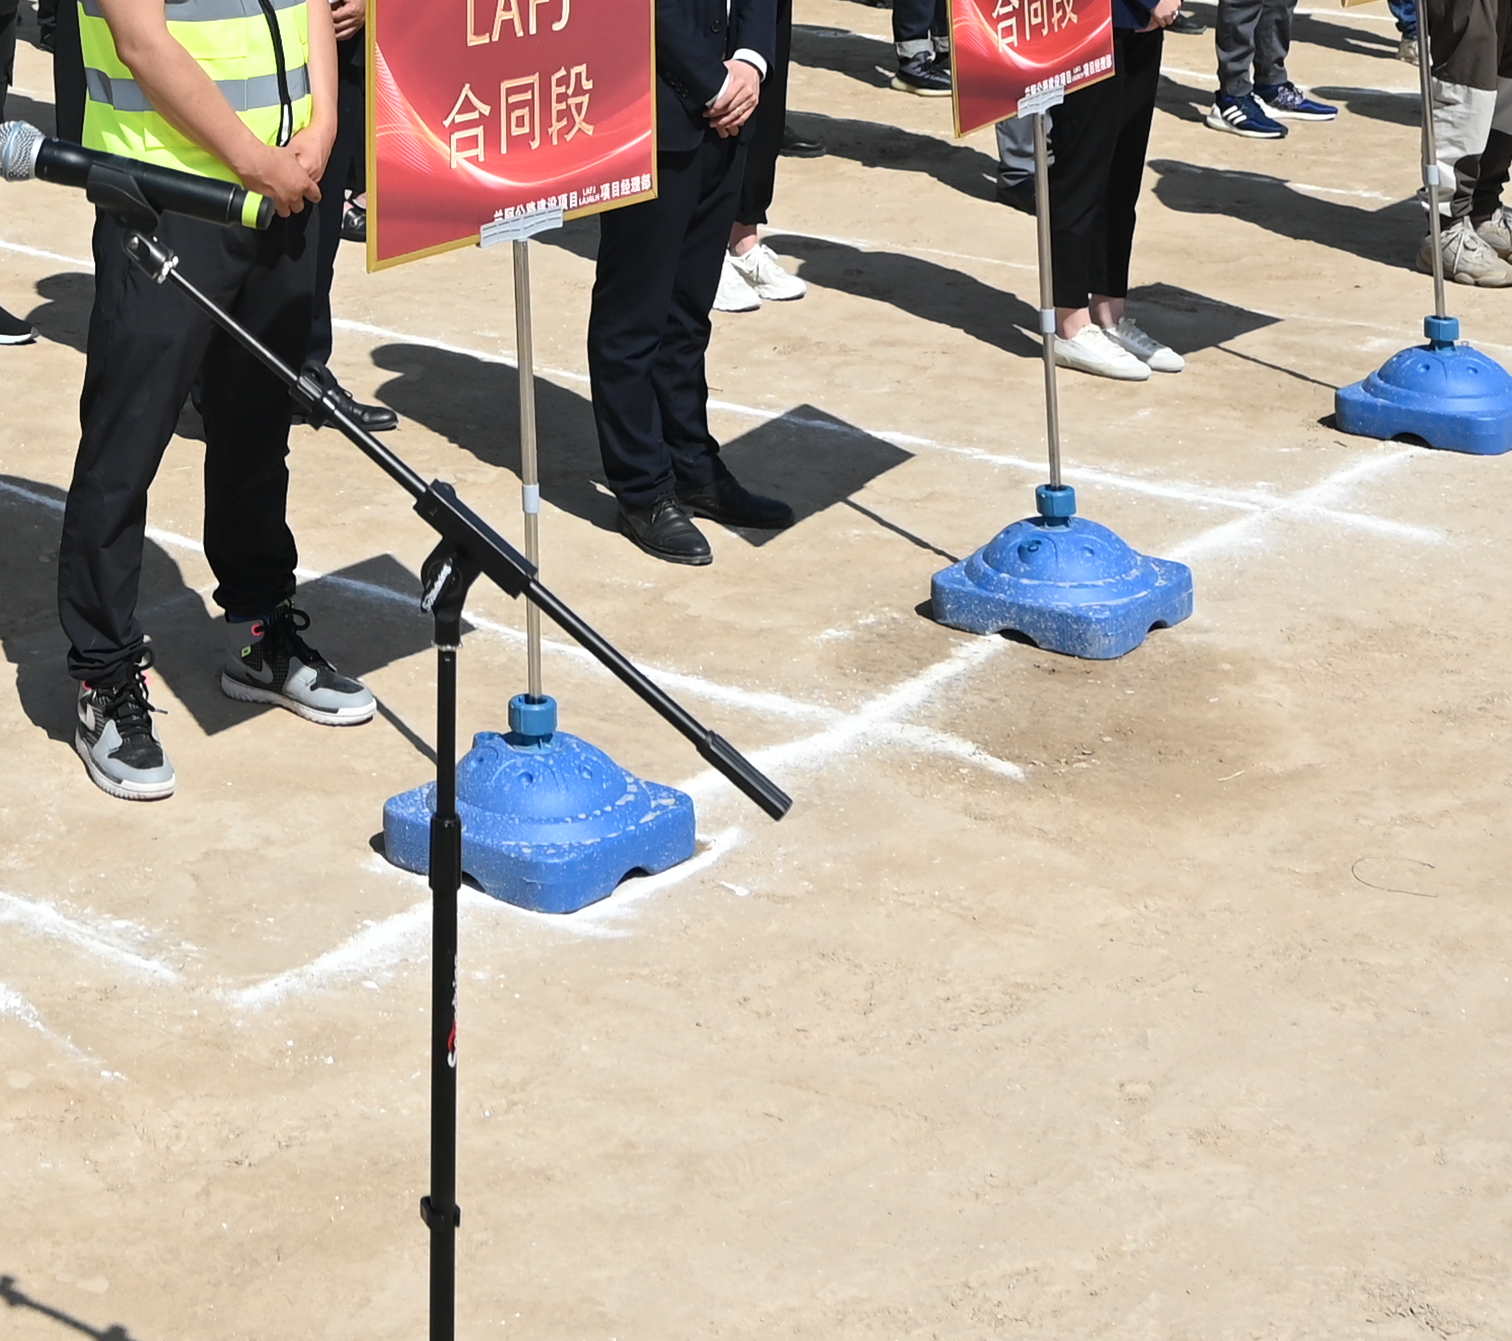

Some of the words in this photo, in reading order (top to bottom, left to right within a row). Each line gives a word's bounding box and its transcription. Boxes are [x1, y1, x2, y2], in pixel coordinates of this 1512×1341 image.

[442, 62, 595, 170] 合同段
[599, 173, 652, 201] 项目经理部
